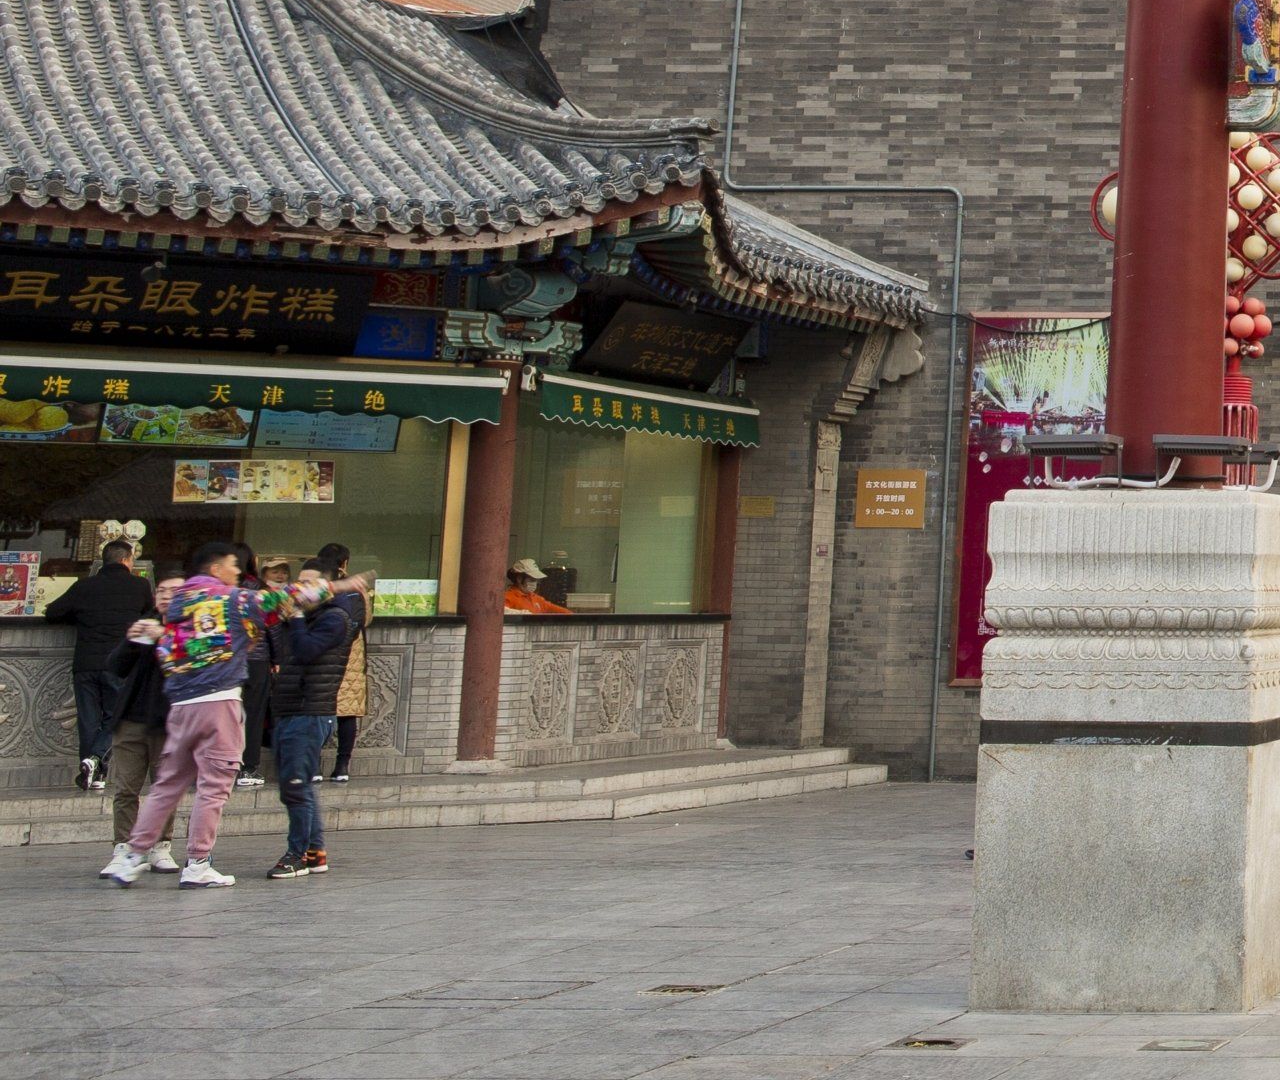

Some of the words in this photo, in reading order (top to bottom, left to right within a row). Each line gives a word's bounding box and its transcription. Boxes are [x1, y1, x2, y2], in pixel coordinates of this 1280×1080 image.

[0, 271, 339, 322] 耳朵眼炸糕
[209, 384, 386, 412] 天津三绝
[865, 481, 917, 489] 古文化街旅游区
[875, 494, 906, 502] 开放时间
